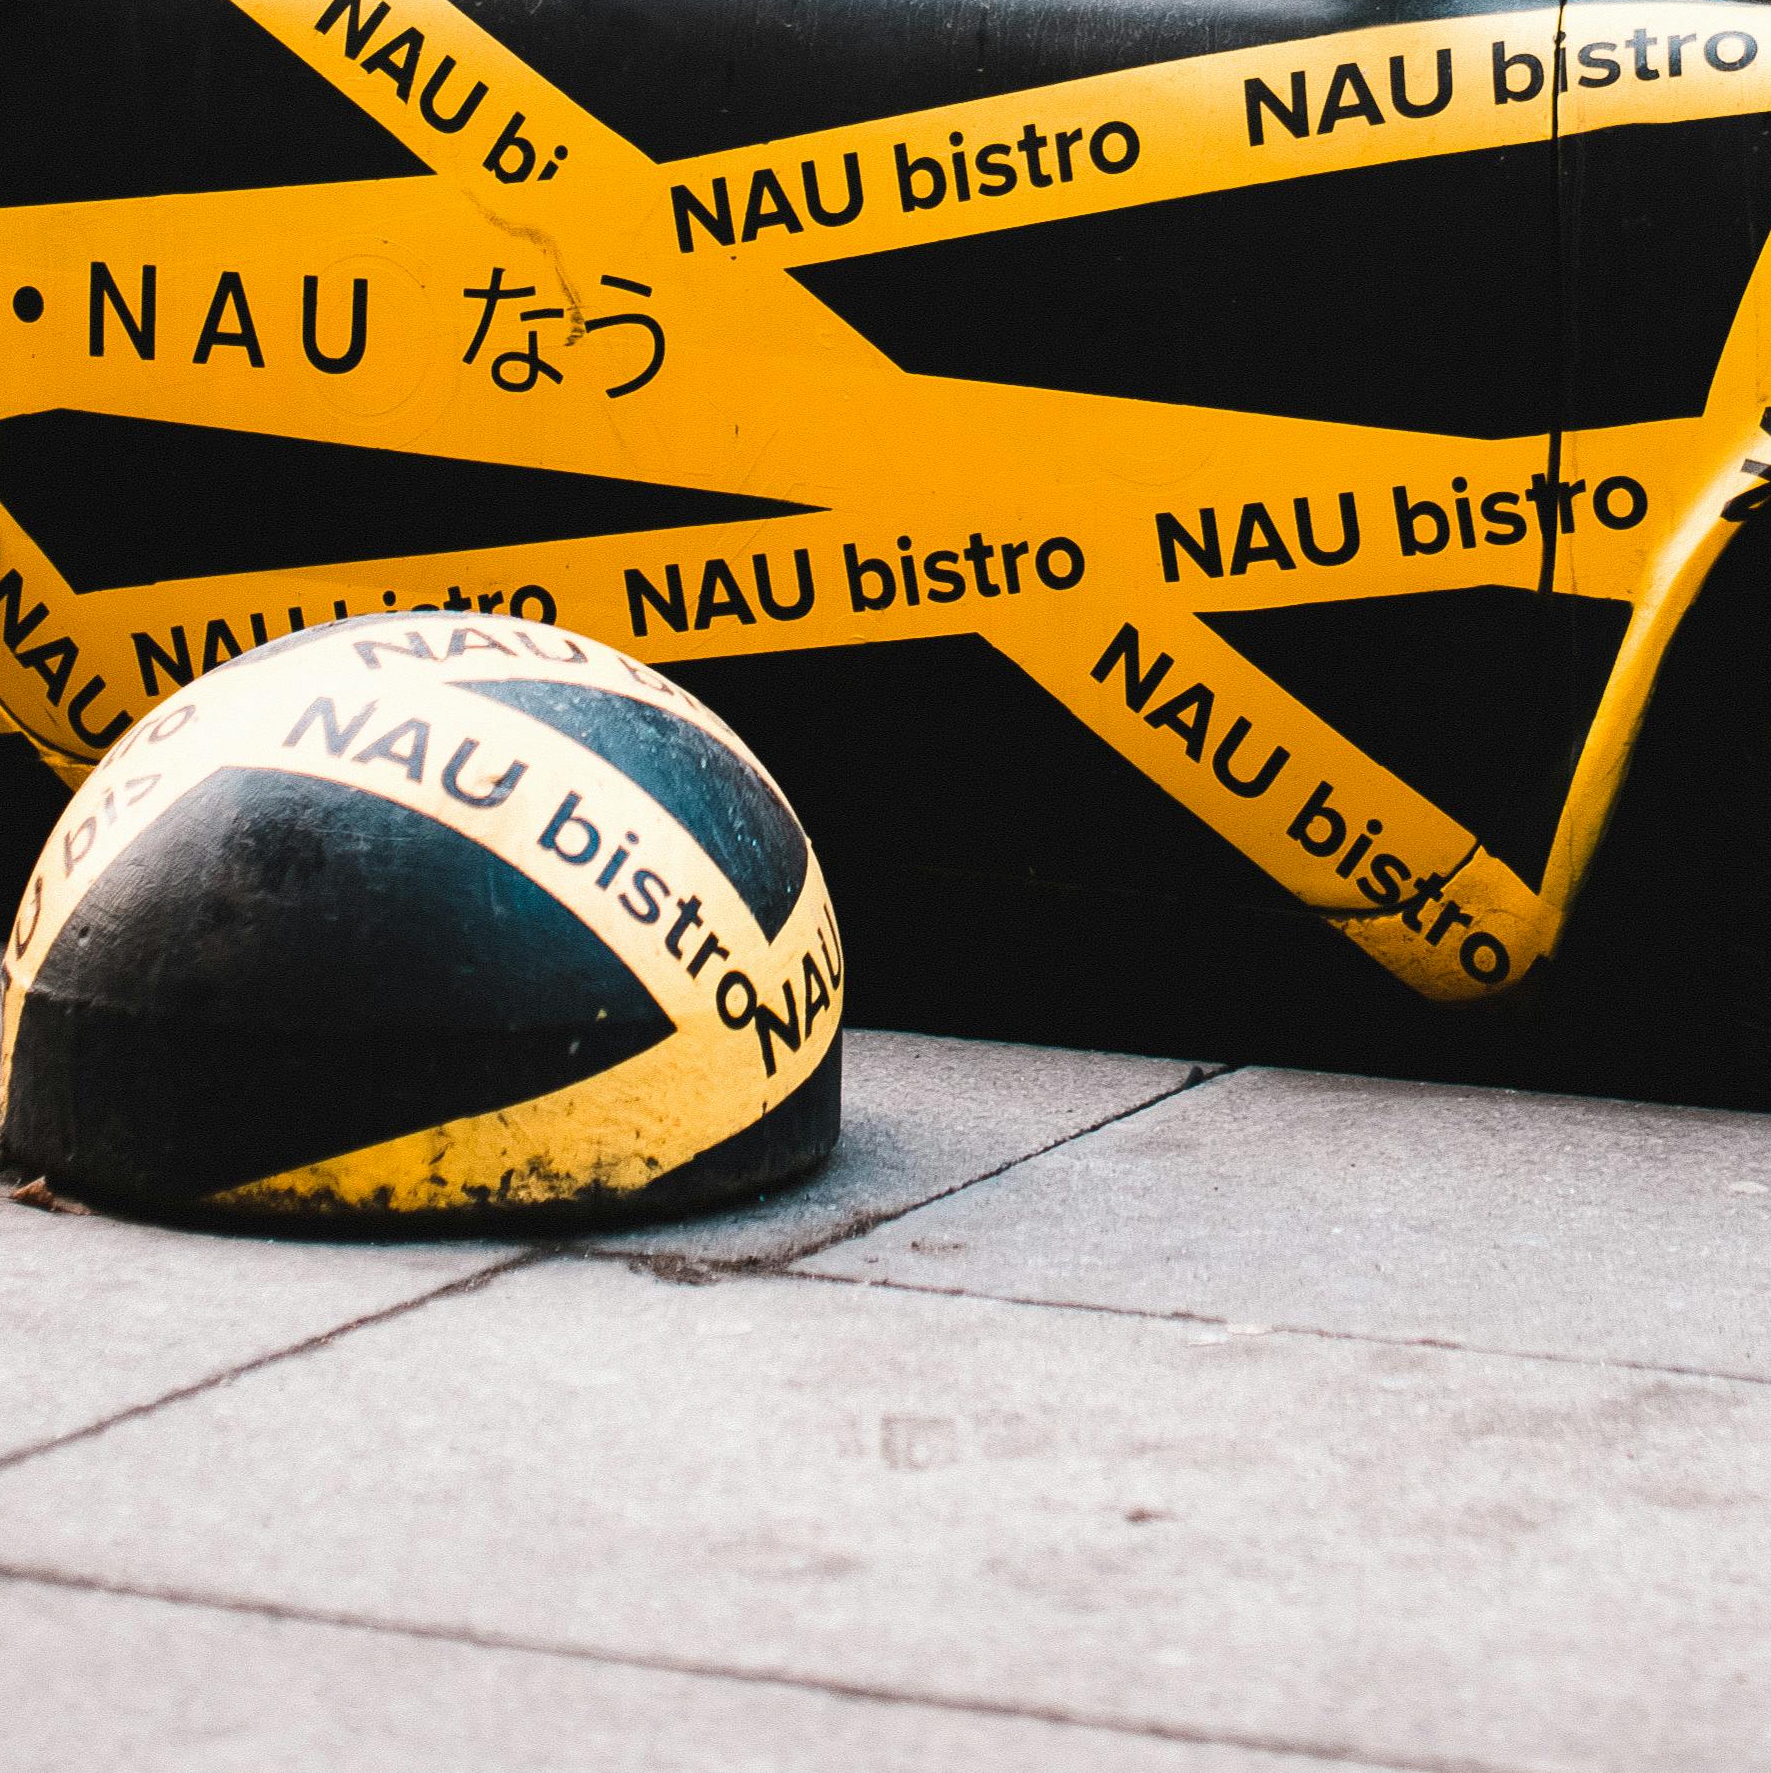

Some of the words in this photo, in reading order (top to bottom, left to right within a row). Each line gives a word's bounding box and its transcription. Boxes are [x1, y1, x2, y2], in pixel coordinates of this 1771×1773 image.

[670, 152, 865, 254] NAU
[894, 120, 1141, 213] bistro
[1243, 48, 1454, 147] NAU
[1491, 27, 1758, 107] bistro
[88, 261, 368, 375] NAU
[462, 268, 667, 399] なう
[624, 548, 816, 638] NAU
[842, 533, 1085, 613] bistro
[1155, 491, 1360, 584] NAU
[1393, 471, 1648, 557] bistro
[353, 627, 589, 670] NAU
[284, 696, 528, 811] NAU
[537, 790, 759, 1032] bistro
[1090, 622, 1291, 798] NAU
[1286, 781, 1511, 985] bistro
[754, 903, 842, 1079] NAU
